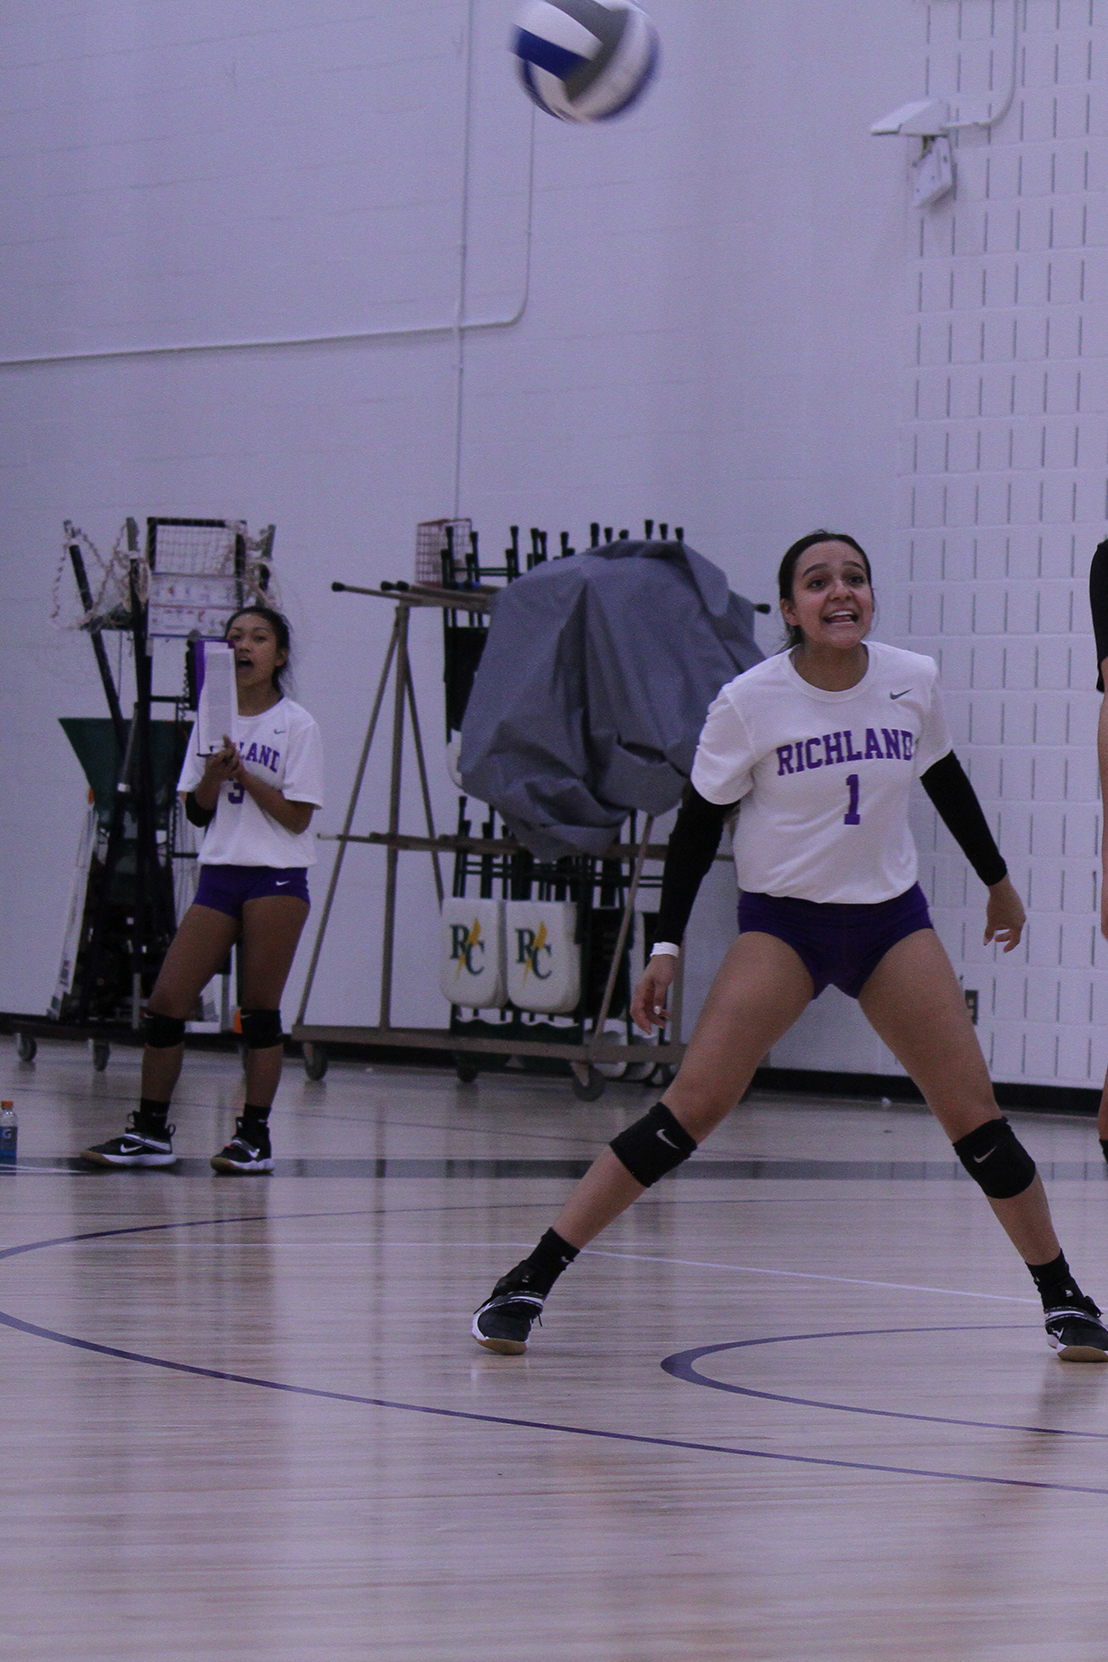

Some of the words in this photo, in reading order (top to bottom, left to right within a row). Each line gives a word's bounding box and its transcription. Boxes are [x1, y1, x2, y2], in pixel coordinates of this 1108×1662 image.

[776, 728, 914, 776] RICHLAND
[844, 774, 861, 825] 1
[449, 923, 485, 975] RC
[515, 927, 552, 980] RC
